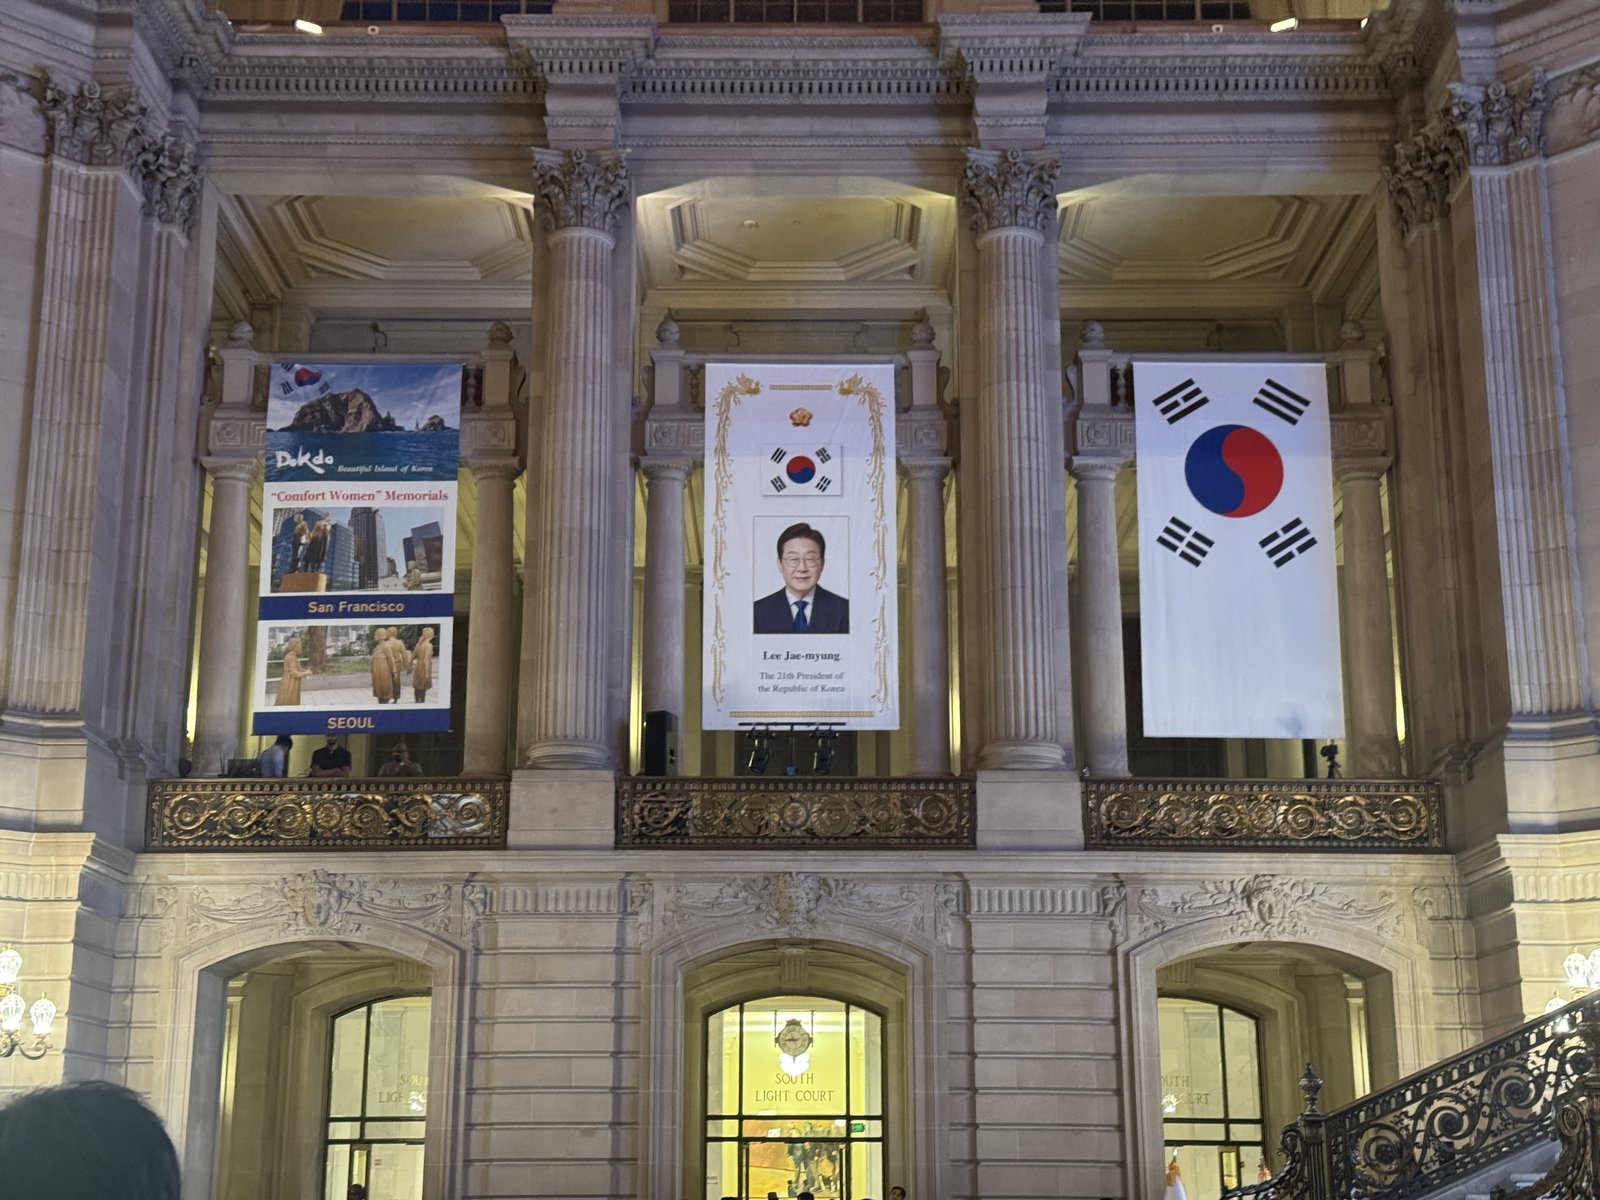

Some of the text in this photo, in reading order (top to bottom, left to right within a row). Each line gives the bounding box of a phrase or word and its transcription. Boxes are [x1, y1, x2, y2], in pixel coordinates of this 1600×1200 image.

[337, 464, 371, 474] Beautiful
[374, 464, 398, 473] Island
[400, 464, 408, 473] of
[411, 465, 433, 473] Korea
[384, 489, 449, 501] Memorials
[308, 600, 405, 613] San Francisco
[762, 650, 841, 662] Lee Jae-myung
[759, 672, 775, 680] The
[796, 671, 833, 680] President
[834, 671, 845, 680] of
[758, 684, 845, 694] the Republic of Korea
[327, 716, 375, 730] SEOUL
[755, 1089, 834, 1102] LIGHT COURT
